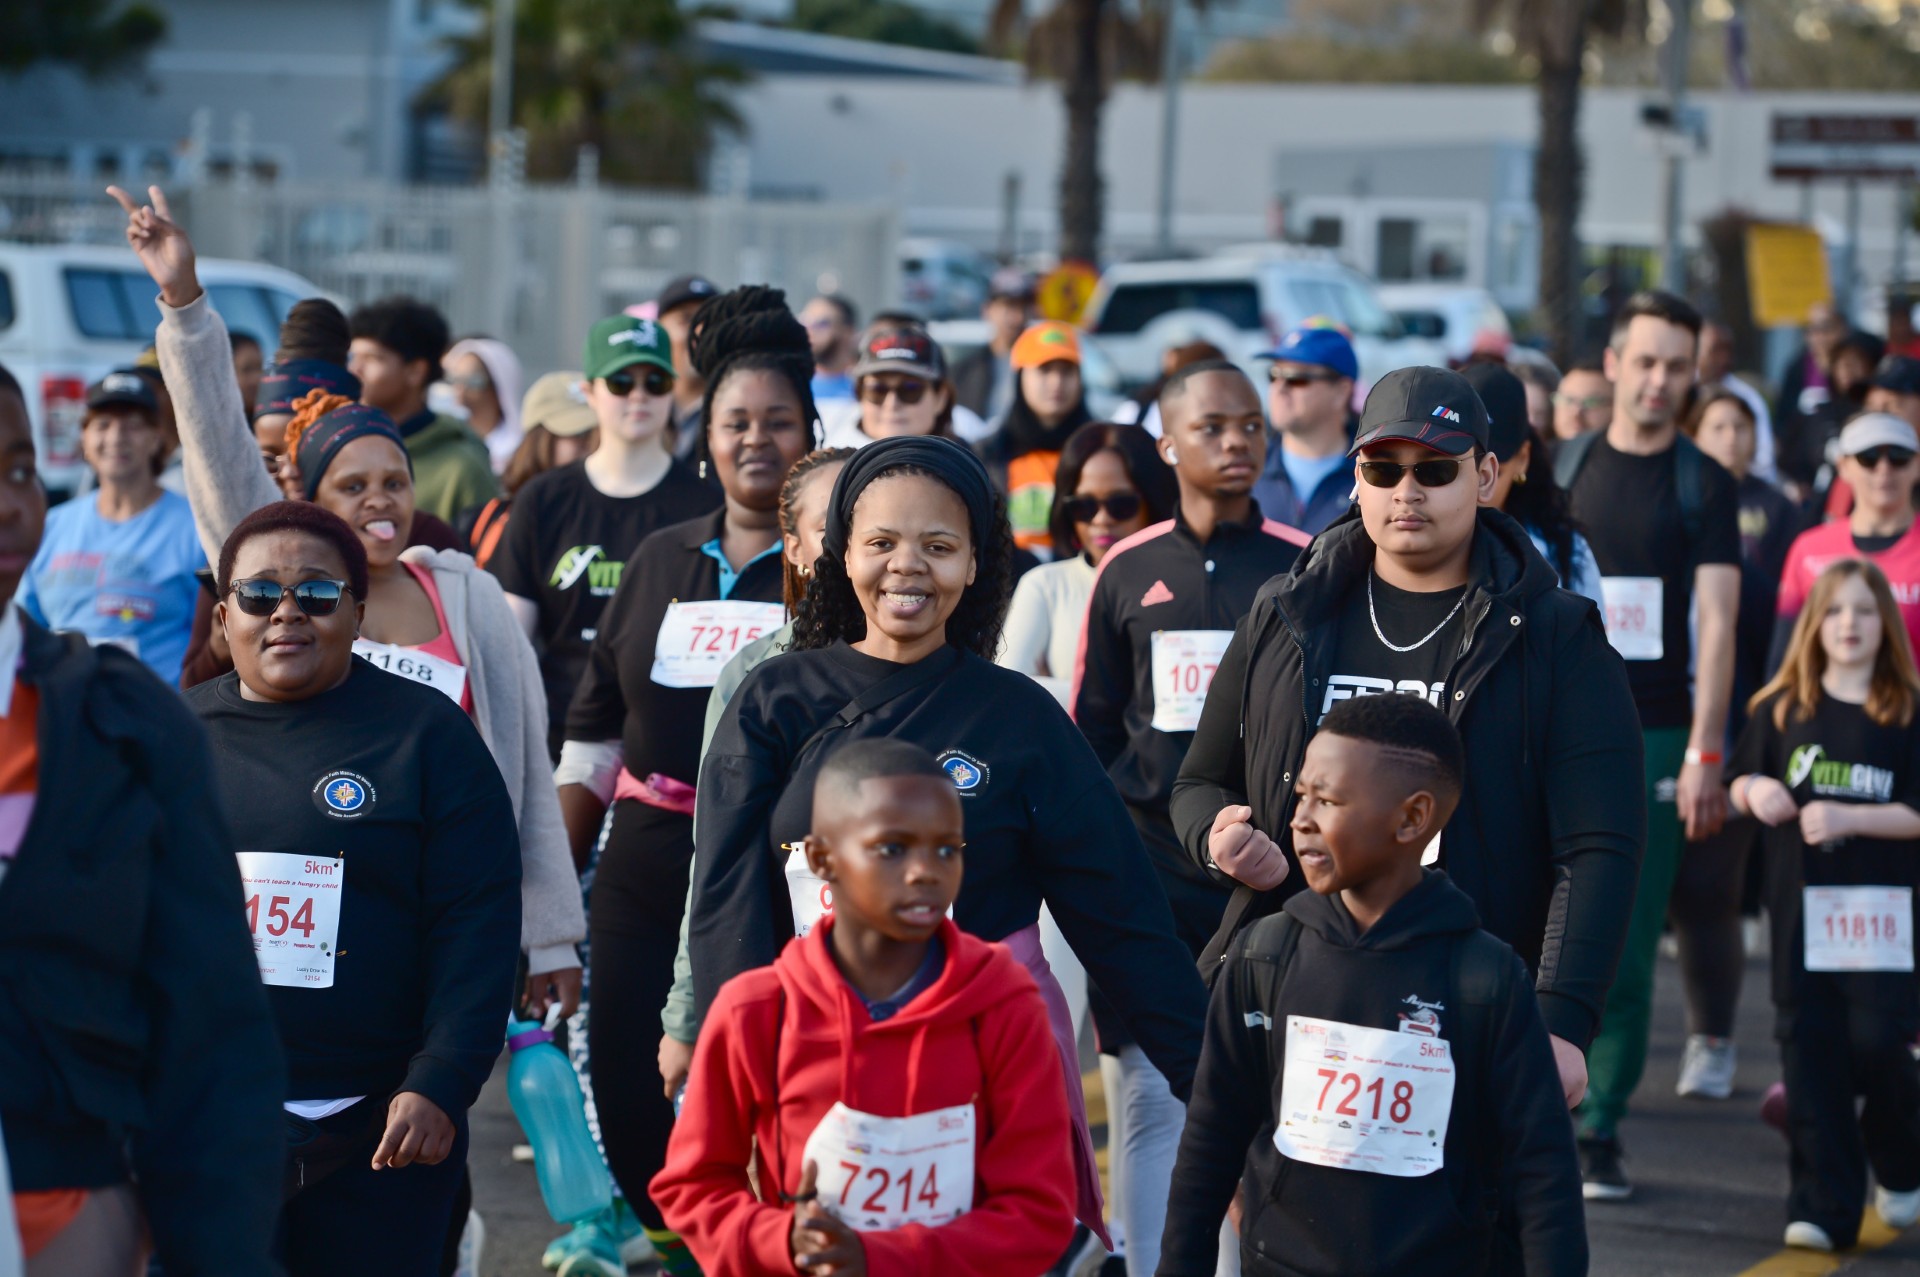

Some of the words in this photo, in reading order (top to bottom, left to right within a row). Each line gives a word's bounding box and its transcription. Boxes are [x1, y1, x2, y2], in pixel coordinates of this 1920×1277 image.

[304, 860, 333, 875] 5km
[297, 881, 320, 889] hungry
[1419, 1042, 1446, 1058] 5km
[1317, 1068, 1414, 1124] 7218
[835, 1160, 939, 1213] 7214
